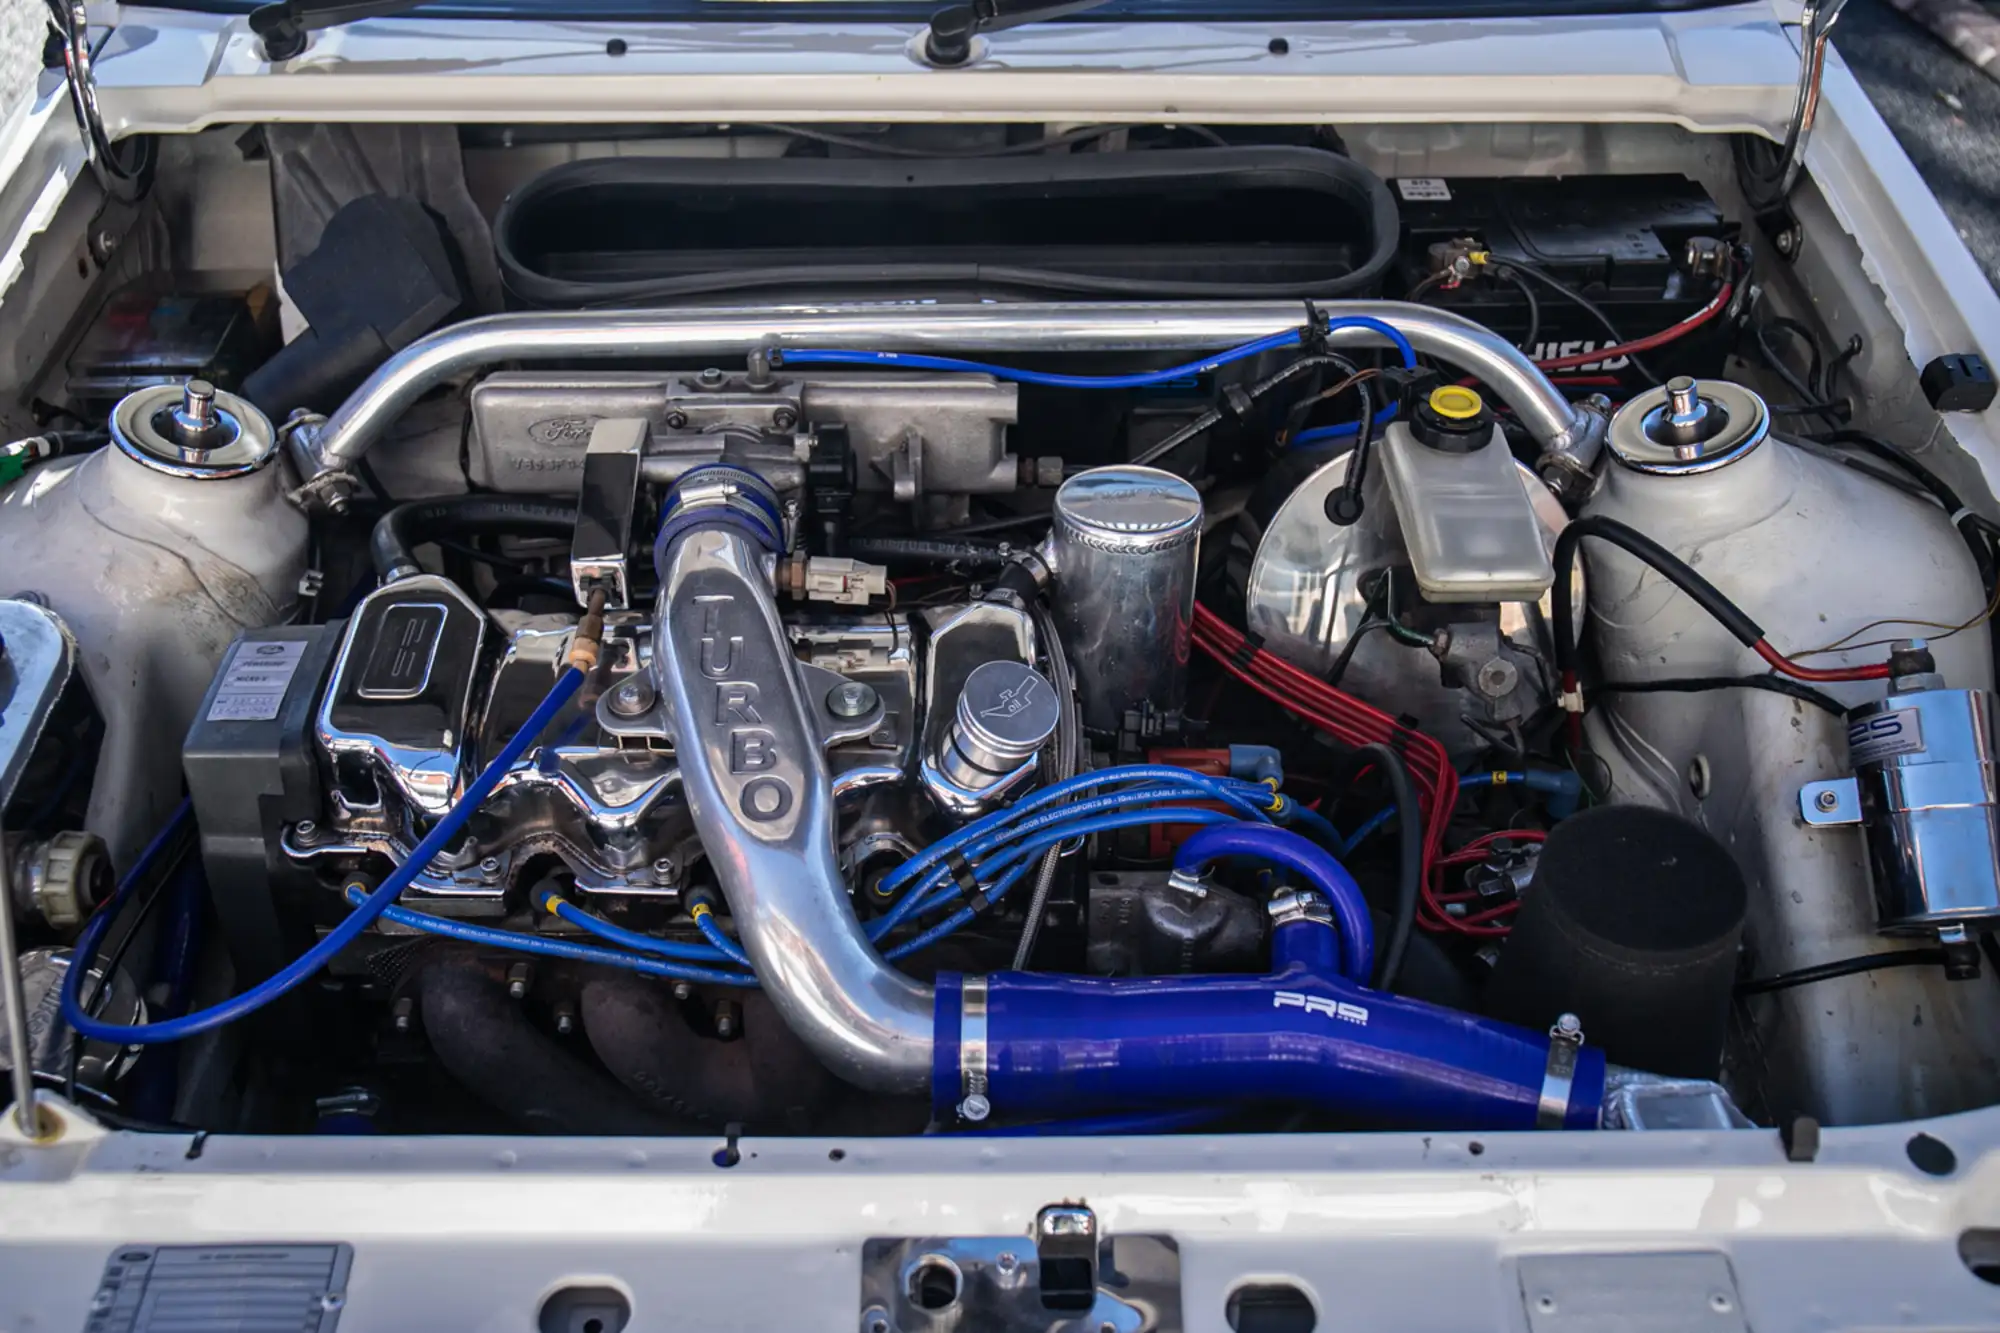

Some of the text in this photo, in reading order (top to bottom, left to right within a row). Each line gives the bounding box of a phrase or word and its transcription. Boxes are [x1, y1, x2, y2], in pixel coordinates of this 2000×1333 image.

[693, 595, 793, 822] TURBO
[1008, 699, 1021, 713] oil
[1273, 991, 1369, 1021] PRO
